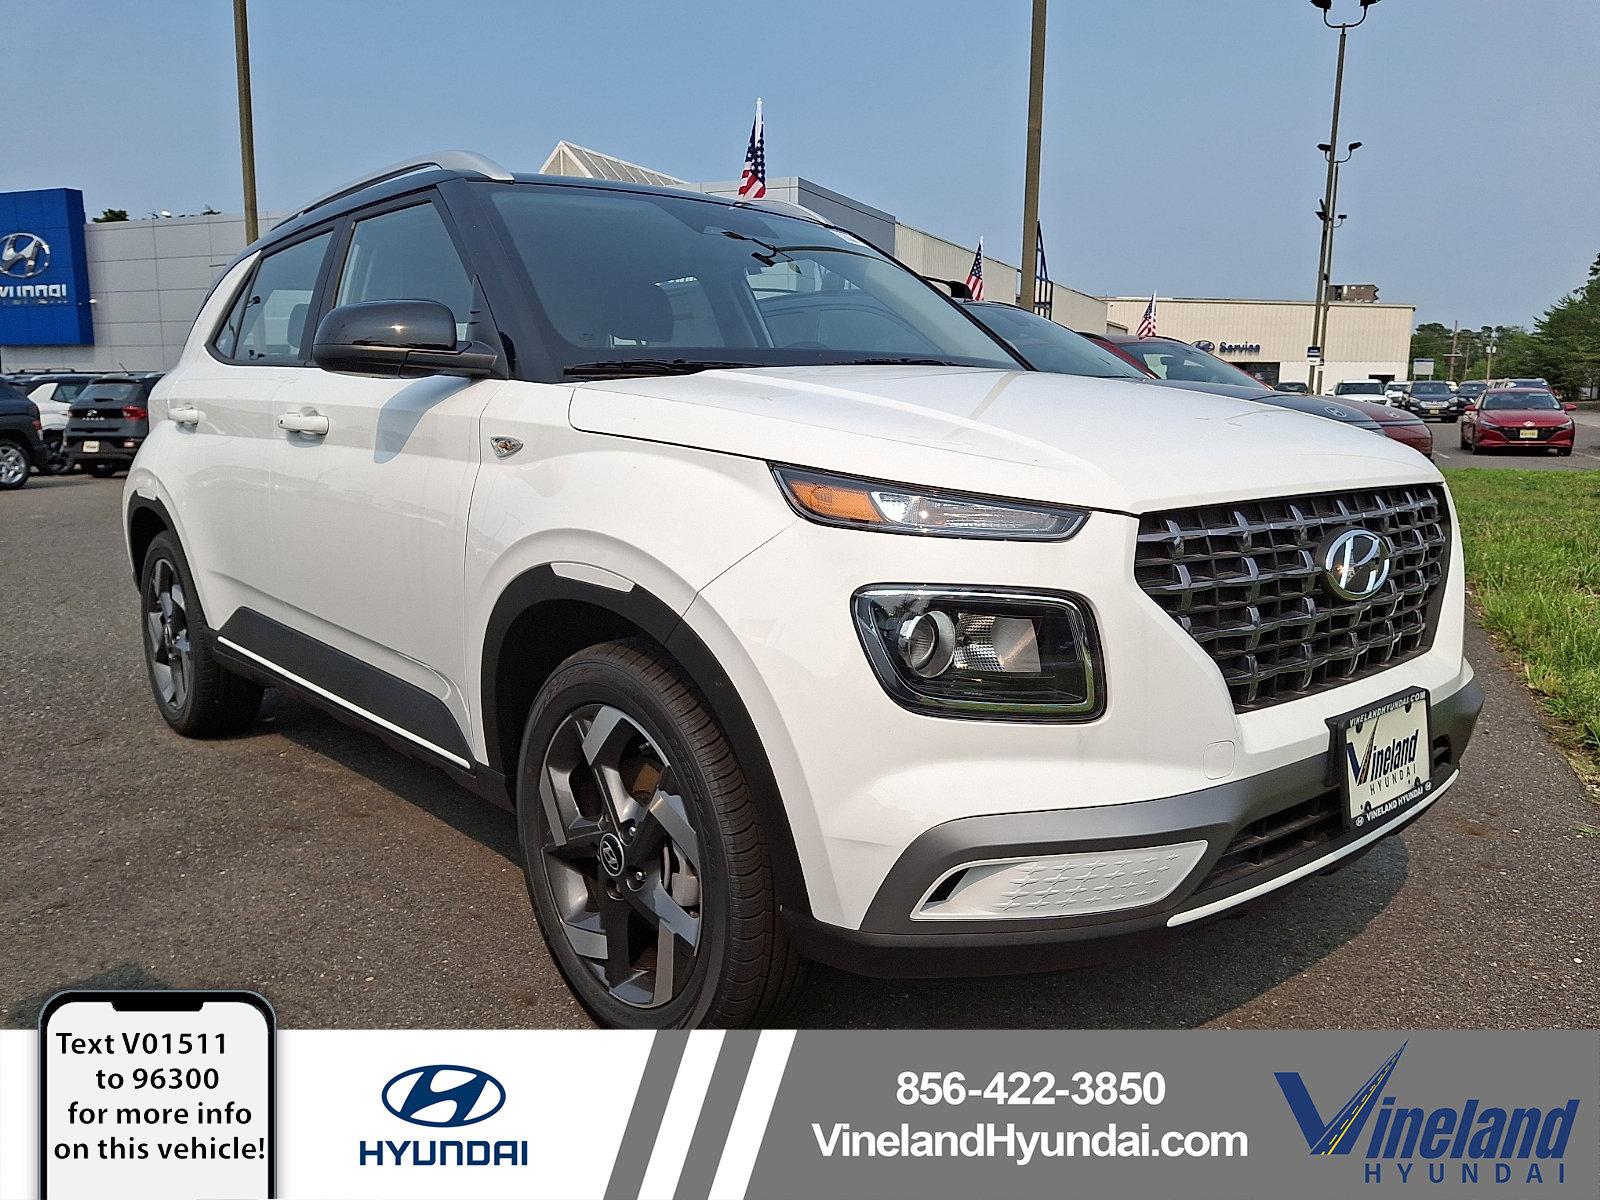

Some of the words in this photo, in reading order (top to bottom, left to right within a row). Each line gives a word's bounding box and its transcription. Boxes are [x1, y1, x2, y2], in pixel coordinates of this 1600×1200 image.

[1220, 341, 1260, 353] Service
[1350, 691, 1426, 727] VINELANDHYUNDAI.COM
[1346, 717, 1419, 786] Vineland
[1369, 763, 1417, 797] HYUNDAI
[1366, 801, 1398, 822] VINELAND
[1397, 788, 1424, 807] HYUNDAI
